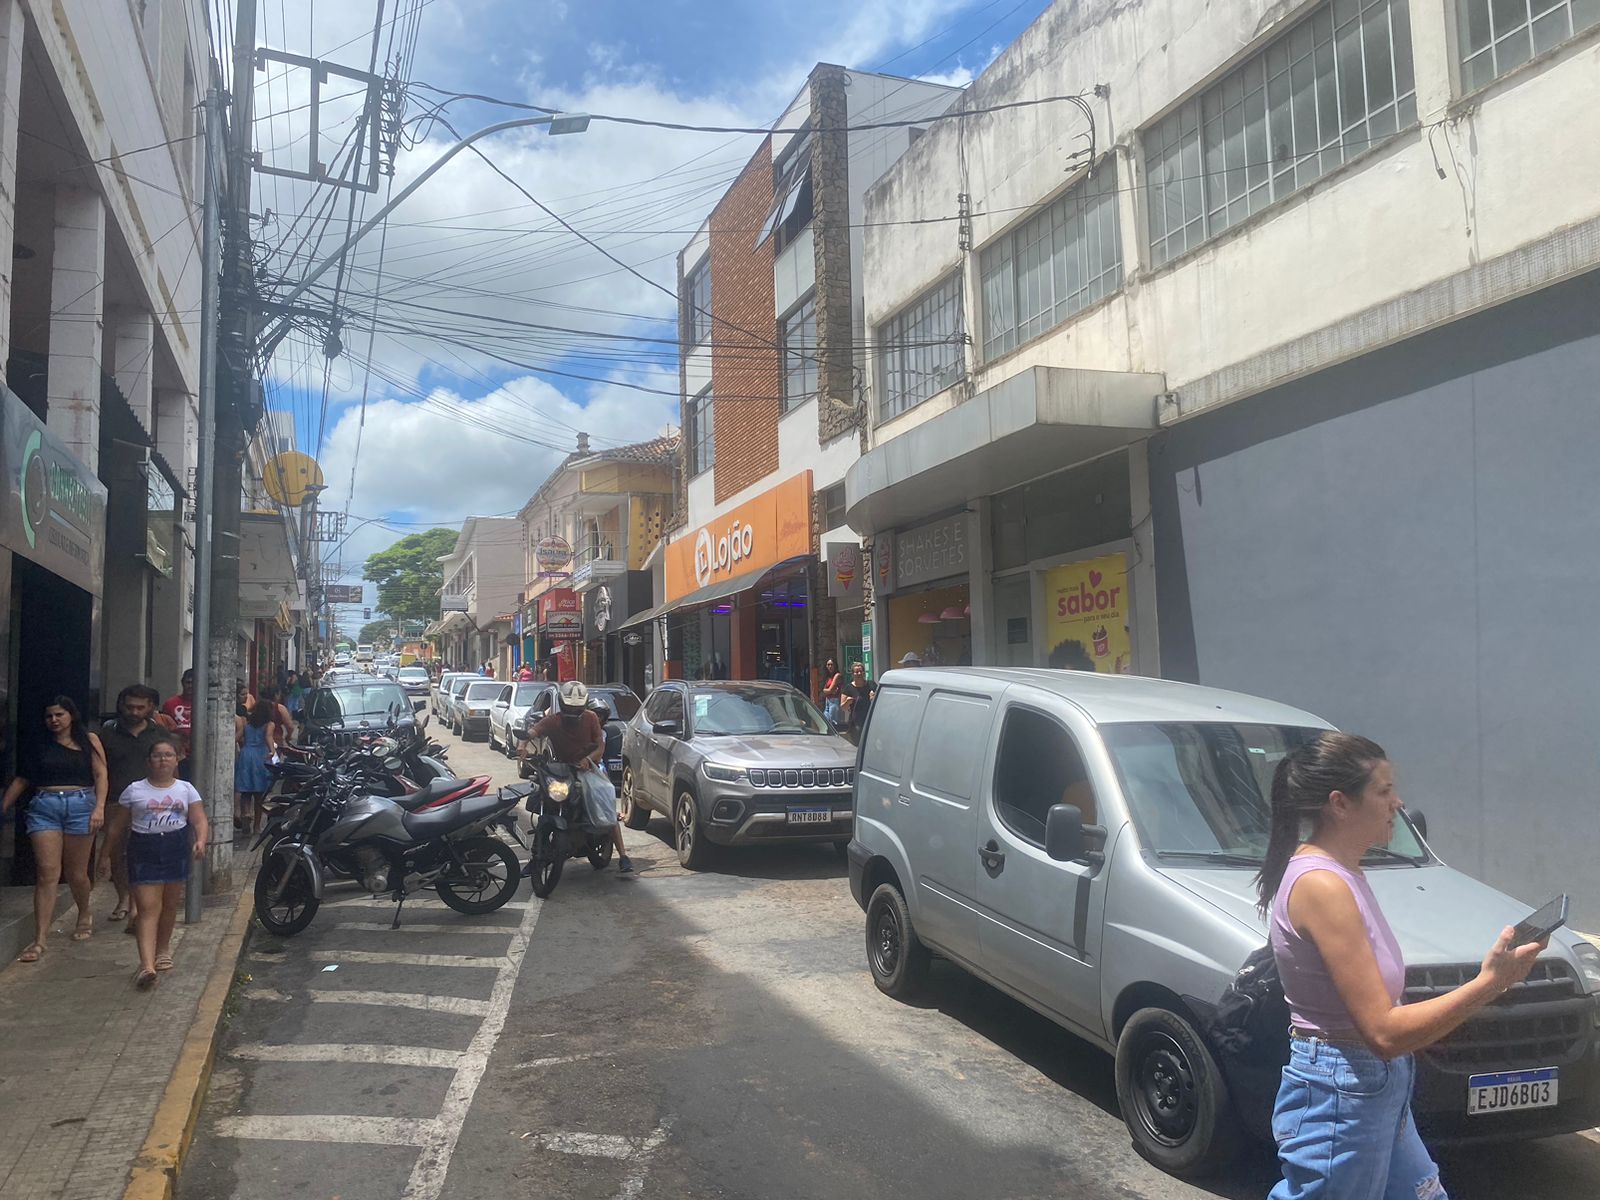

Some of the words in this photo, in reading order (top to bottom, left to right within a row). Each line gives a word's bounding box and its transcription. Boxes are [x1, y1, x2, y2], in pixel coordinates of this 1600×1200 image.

[711, 519, 754, 574] Lojão
[899, 526, 949, 558] SHAKES
[954, 521, 962, 542] E
[897, 543, 965, 579] SORVETES
[1057, 581, 1121, 617] sabor
[1477, 1081, 1551, 1110] EJD6B03
